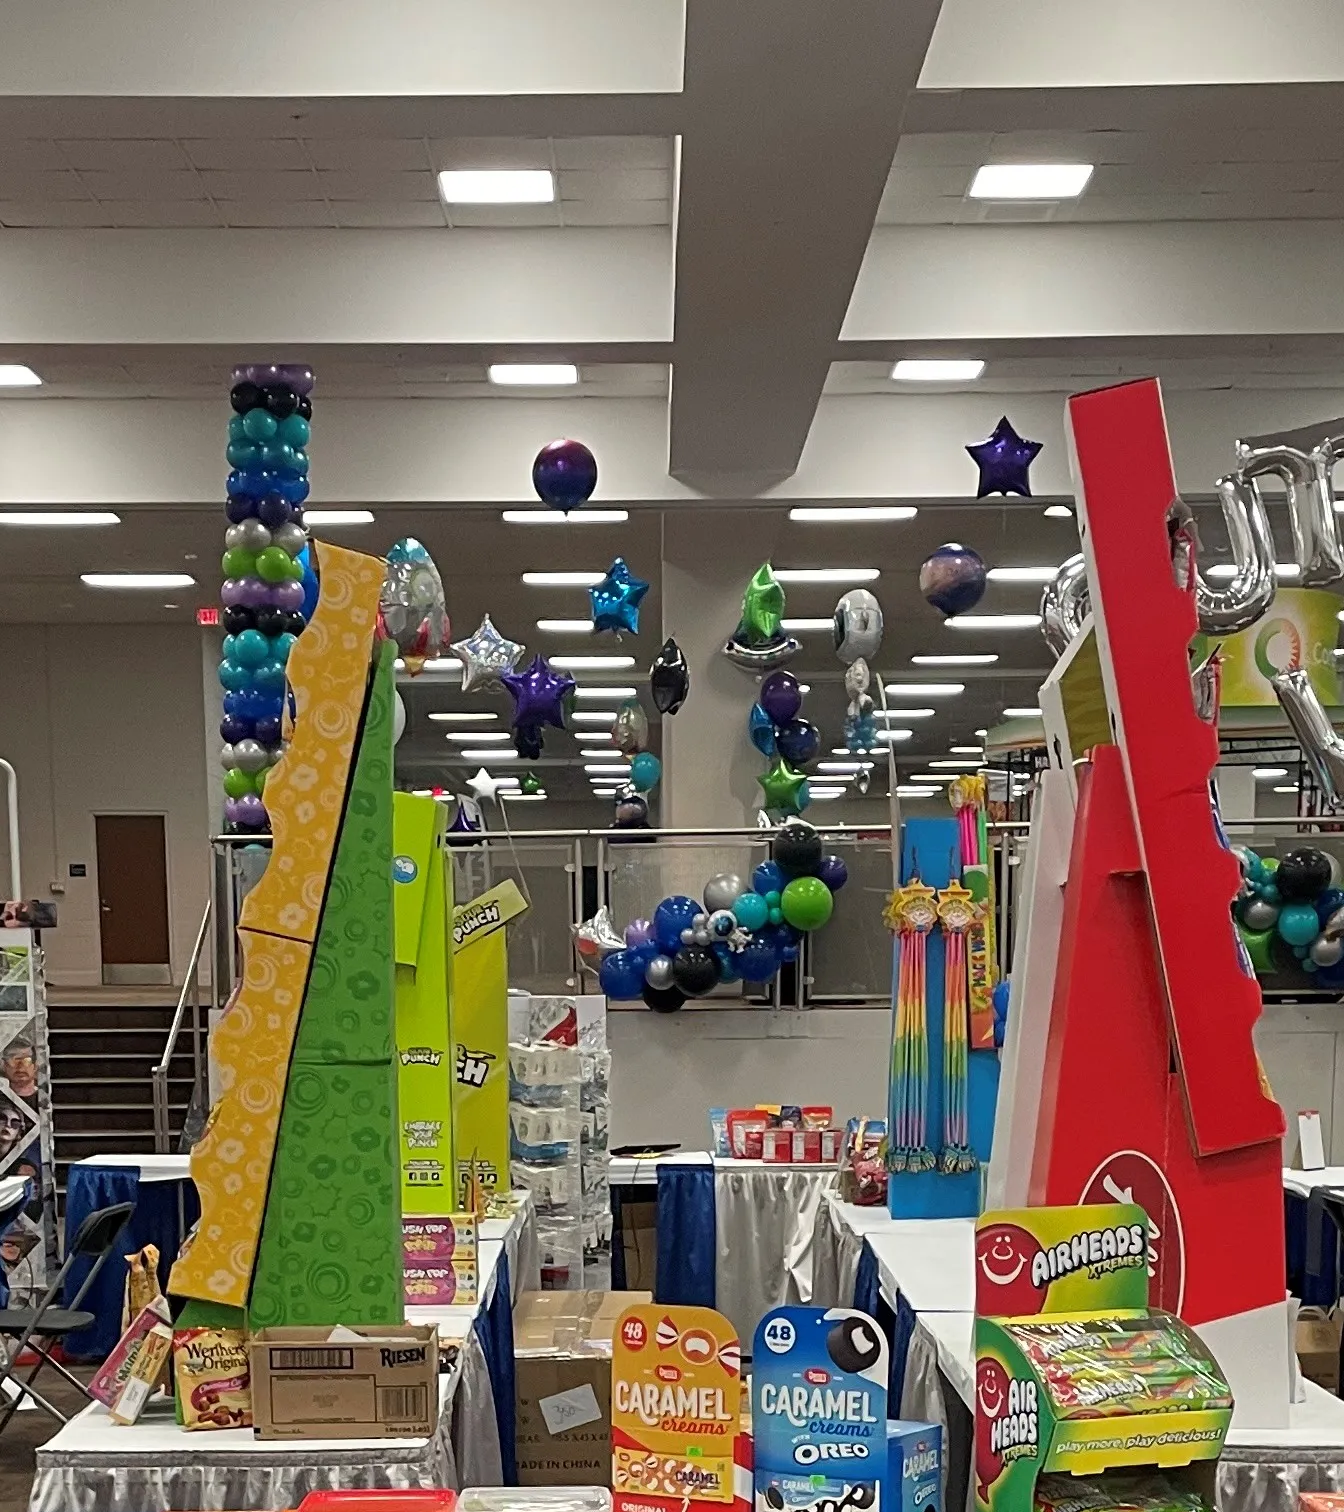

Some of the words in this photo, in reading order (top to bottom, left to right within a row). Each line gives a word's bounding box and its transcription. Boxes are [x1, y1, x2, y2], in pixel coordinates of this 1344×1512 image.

[454, 906, 500, 944] PUNCH
[400, 1052, 442, 1066] PUNCH
[402, 1224, 424, 1234] USH
[425, 1224, 448, 1234] POP
[1031, 1224, 1145, 1288] AIRHEADS
[403, 1269, 425, 1279] USH
[426, 1269, 449, 1279] POP
[1088, 1254, 1144, 1280] XTREMES
[624, 1322, 643, 1340] 48
[766, 1325, 792, 1341] 48
[203, 1353, 249, 1372] Origina
[380, 1347, 426, 1368] RIESEN
[616, 1380, 734, 1426] CARAMEL
[761, 1383, 879, 1428] CARAMEL
[1008, 1379, 1038, 1416] AIR
[661, 1419, 728, 1436] creams
[809, 1420, 873, 1438] creams
[991, 1412, 1038, 1453] HEADS
[1056, 1441, 1084, 1455] play
[1125, 1435, 1156, 1449] play
[1157, 1428, 1222, 1446] delicious!
[562, 1459, 601, 1469] CHINA
[794, 1443, 869, 1465] OREO
[676, 1470, 721, 1487] CARAMEL
